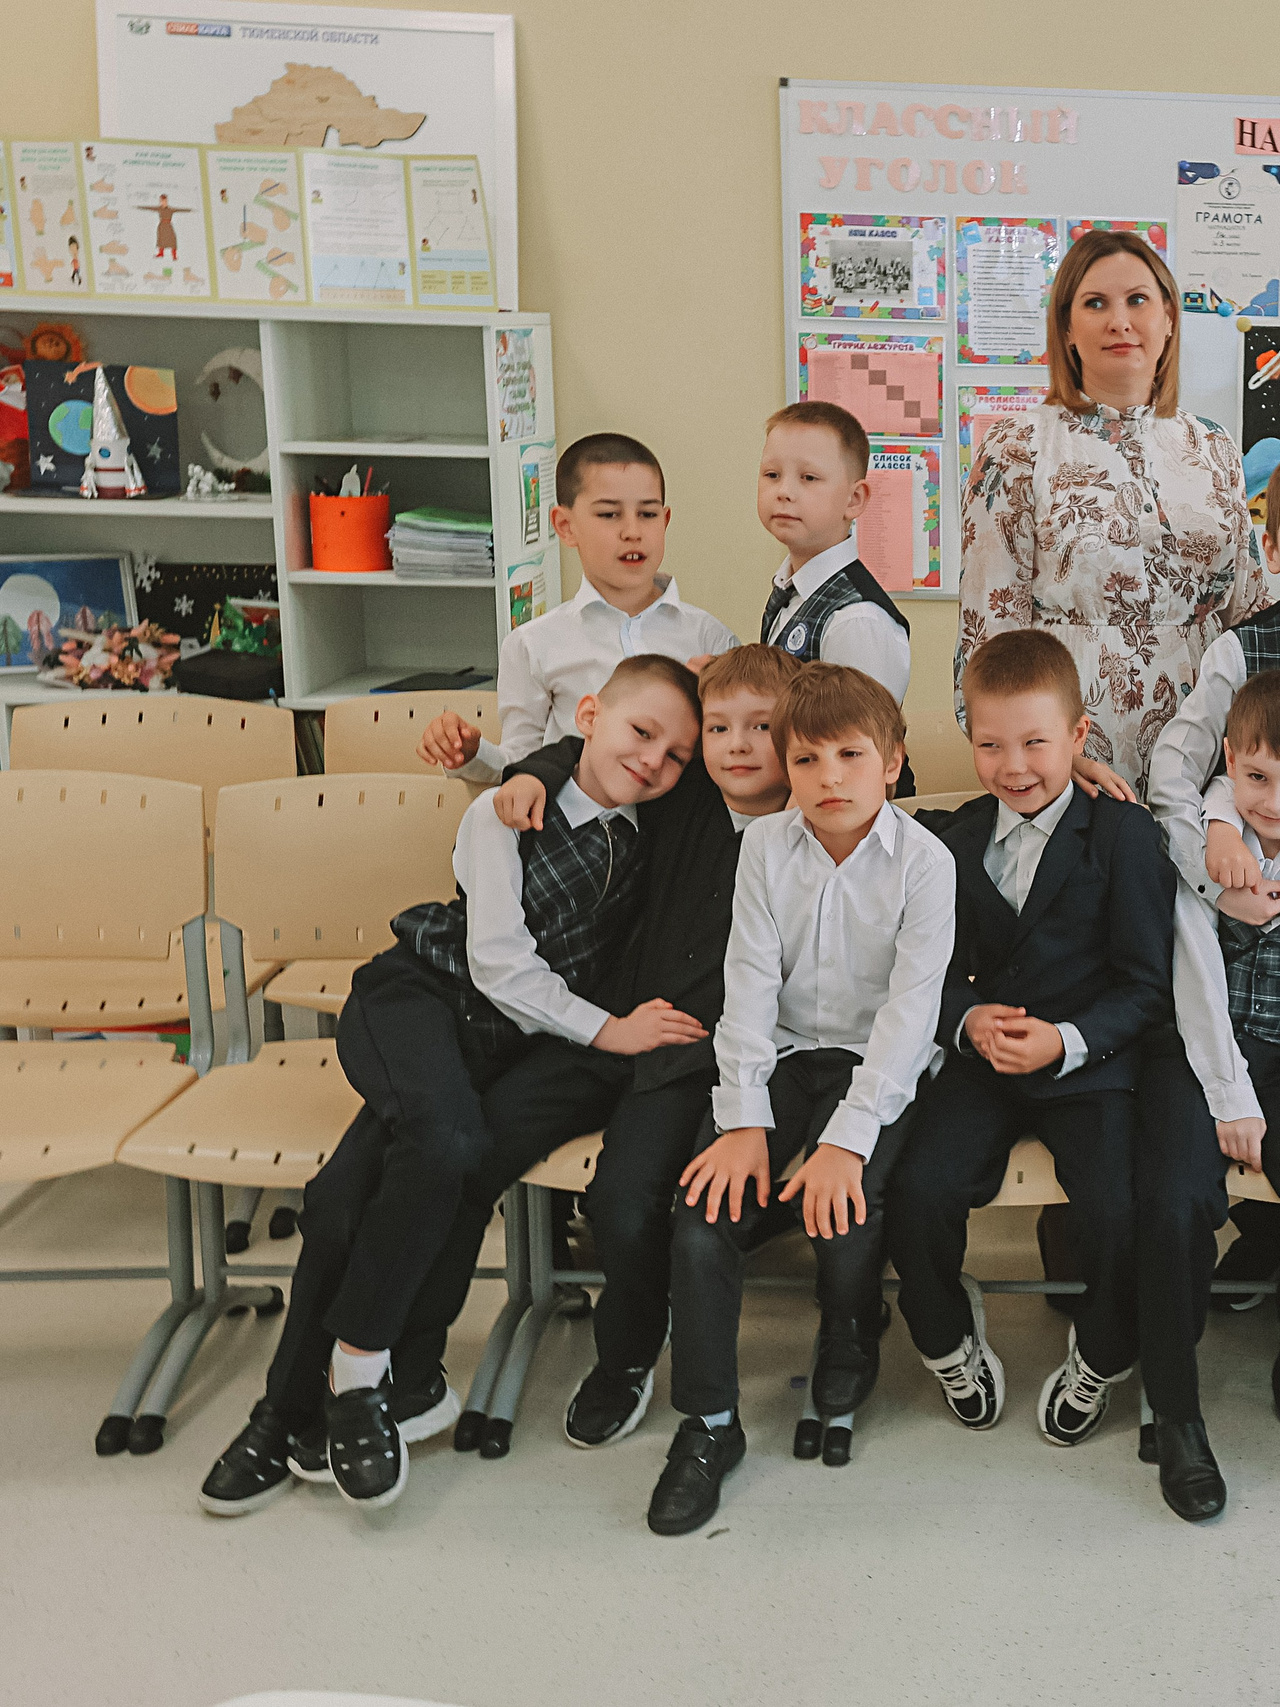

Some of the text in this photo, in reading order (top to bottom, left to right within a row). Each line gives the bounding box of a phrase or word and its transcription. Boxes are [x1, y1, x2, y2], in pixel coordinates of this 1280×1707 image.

[240, 26, 318, 42] ТЮМЕНСКОЙ
[321, 29, 379, 45] ОБЛАСТИ
[798, 99, 1079, 144] КЛАССНЫЙ
[818, 156, 1029, 194] УГОЛОК
[1195, 211, 1263, 224] ГРАМОТА
[868, 230, 897, 238] КЛАСС
[832, 341, 915, 351] ГРАФИК ДЕЖУРСТВ
[978, 396, 1039, 404] РАСПИСАНИЕ
[873, 454, 912, 462] СПИСОК
[874, 462, 911, 470] КЛАССА
